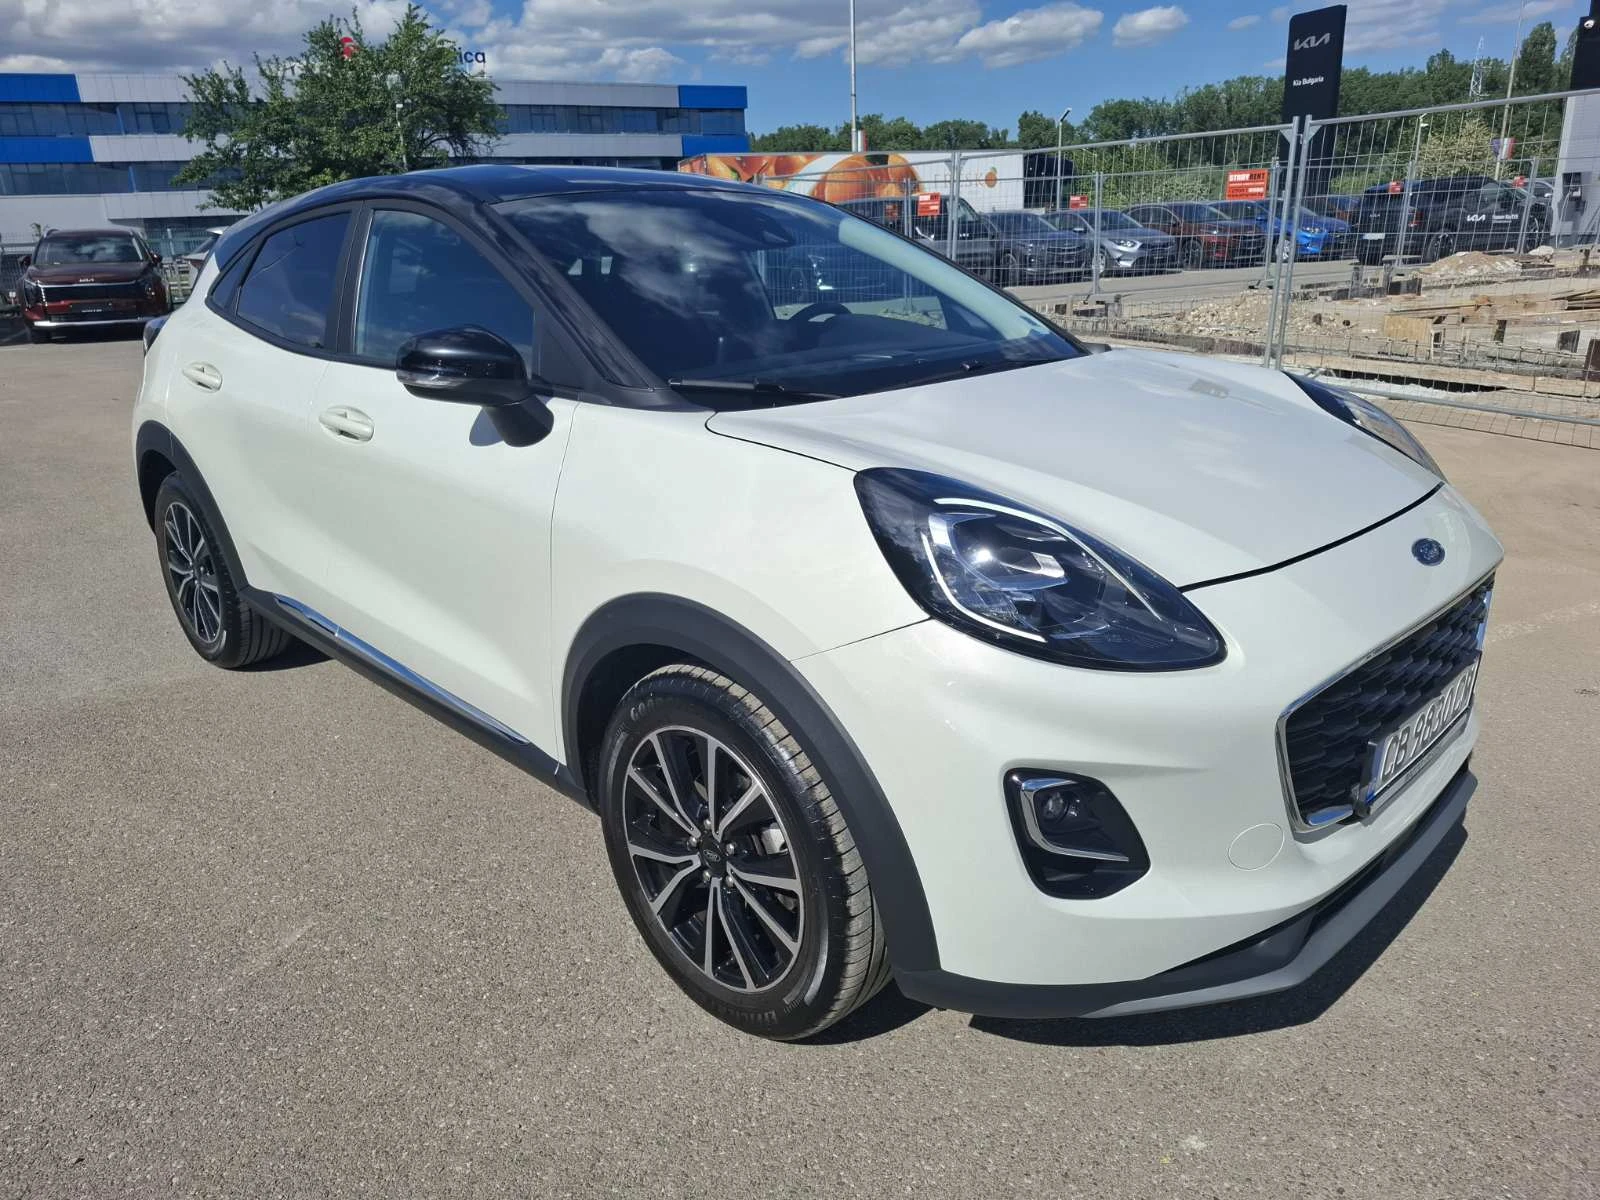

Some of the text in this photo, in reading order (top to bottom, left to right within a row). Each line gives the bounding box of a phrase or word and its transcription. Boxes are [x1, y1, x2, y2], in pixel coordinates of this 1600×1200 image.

[1294, 33, 1331, 50] KIA
[459, 46, 486, 64] ica
[1302, 76, 1324, 85] Bulgaria
[1466, 214, 1486, 222] KIA
